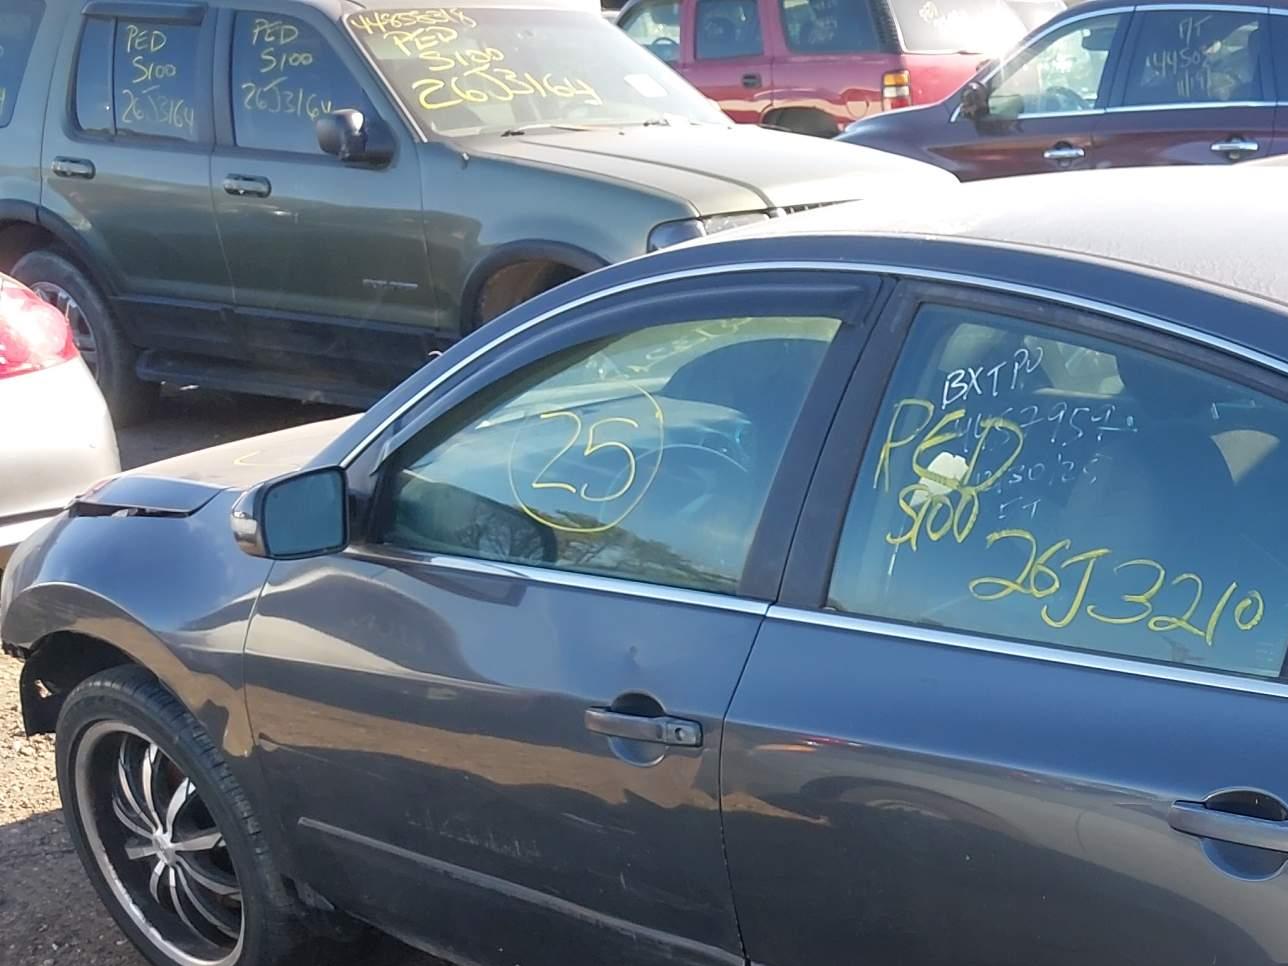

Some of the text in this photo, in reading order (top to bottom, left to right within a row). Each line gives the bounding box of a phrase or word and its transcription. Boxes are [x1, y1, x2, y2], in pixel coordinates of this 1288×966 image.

[126, 25, 167, 53] PED
[251, 18, 299, 45] PED
[383, 26, 458, 56] PED
[131, 55, 177, 84] S100
[259, 47, 313, 73] S100
[531, 410, 639, 501] 25
[872, 398, 1024, 493] PED
[885, 483, 981, 552] S100
[968, 529, 1266, 646] 26J3210
